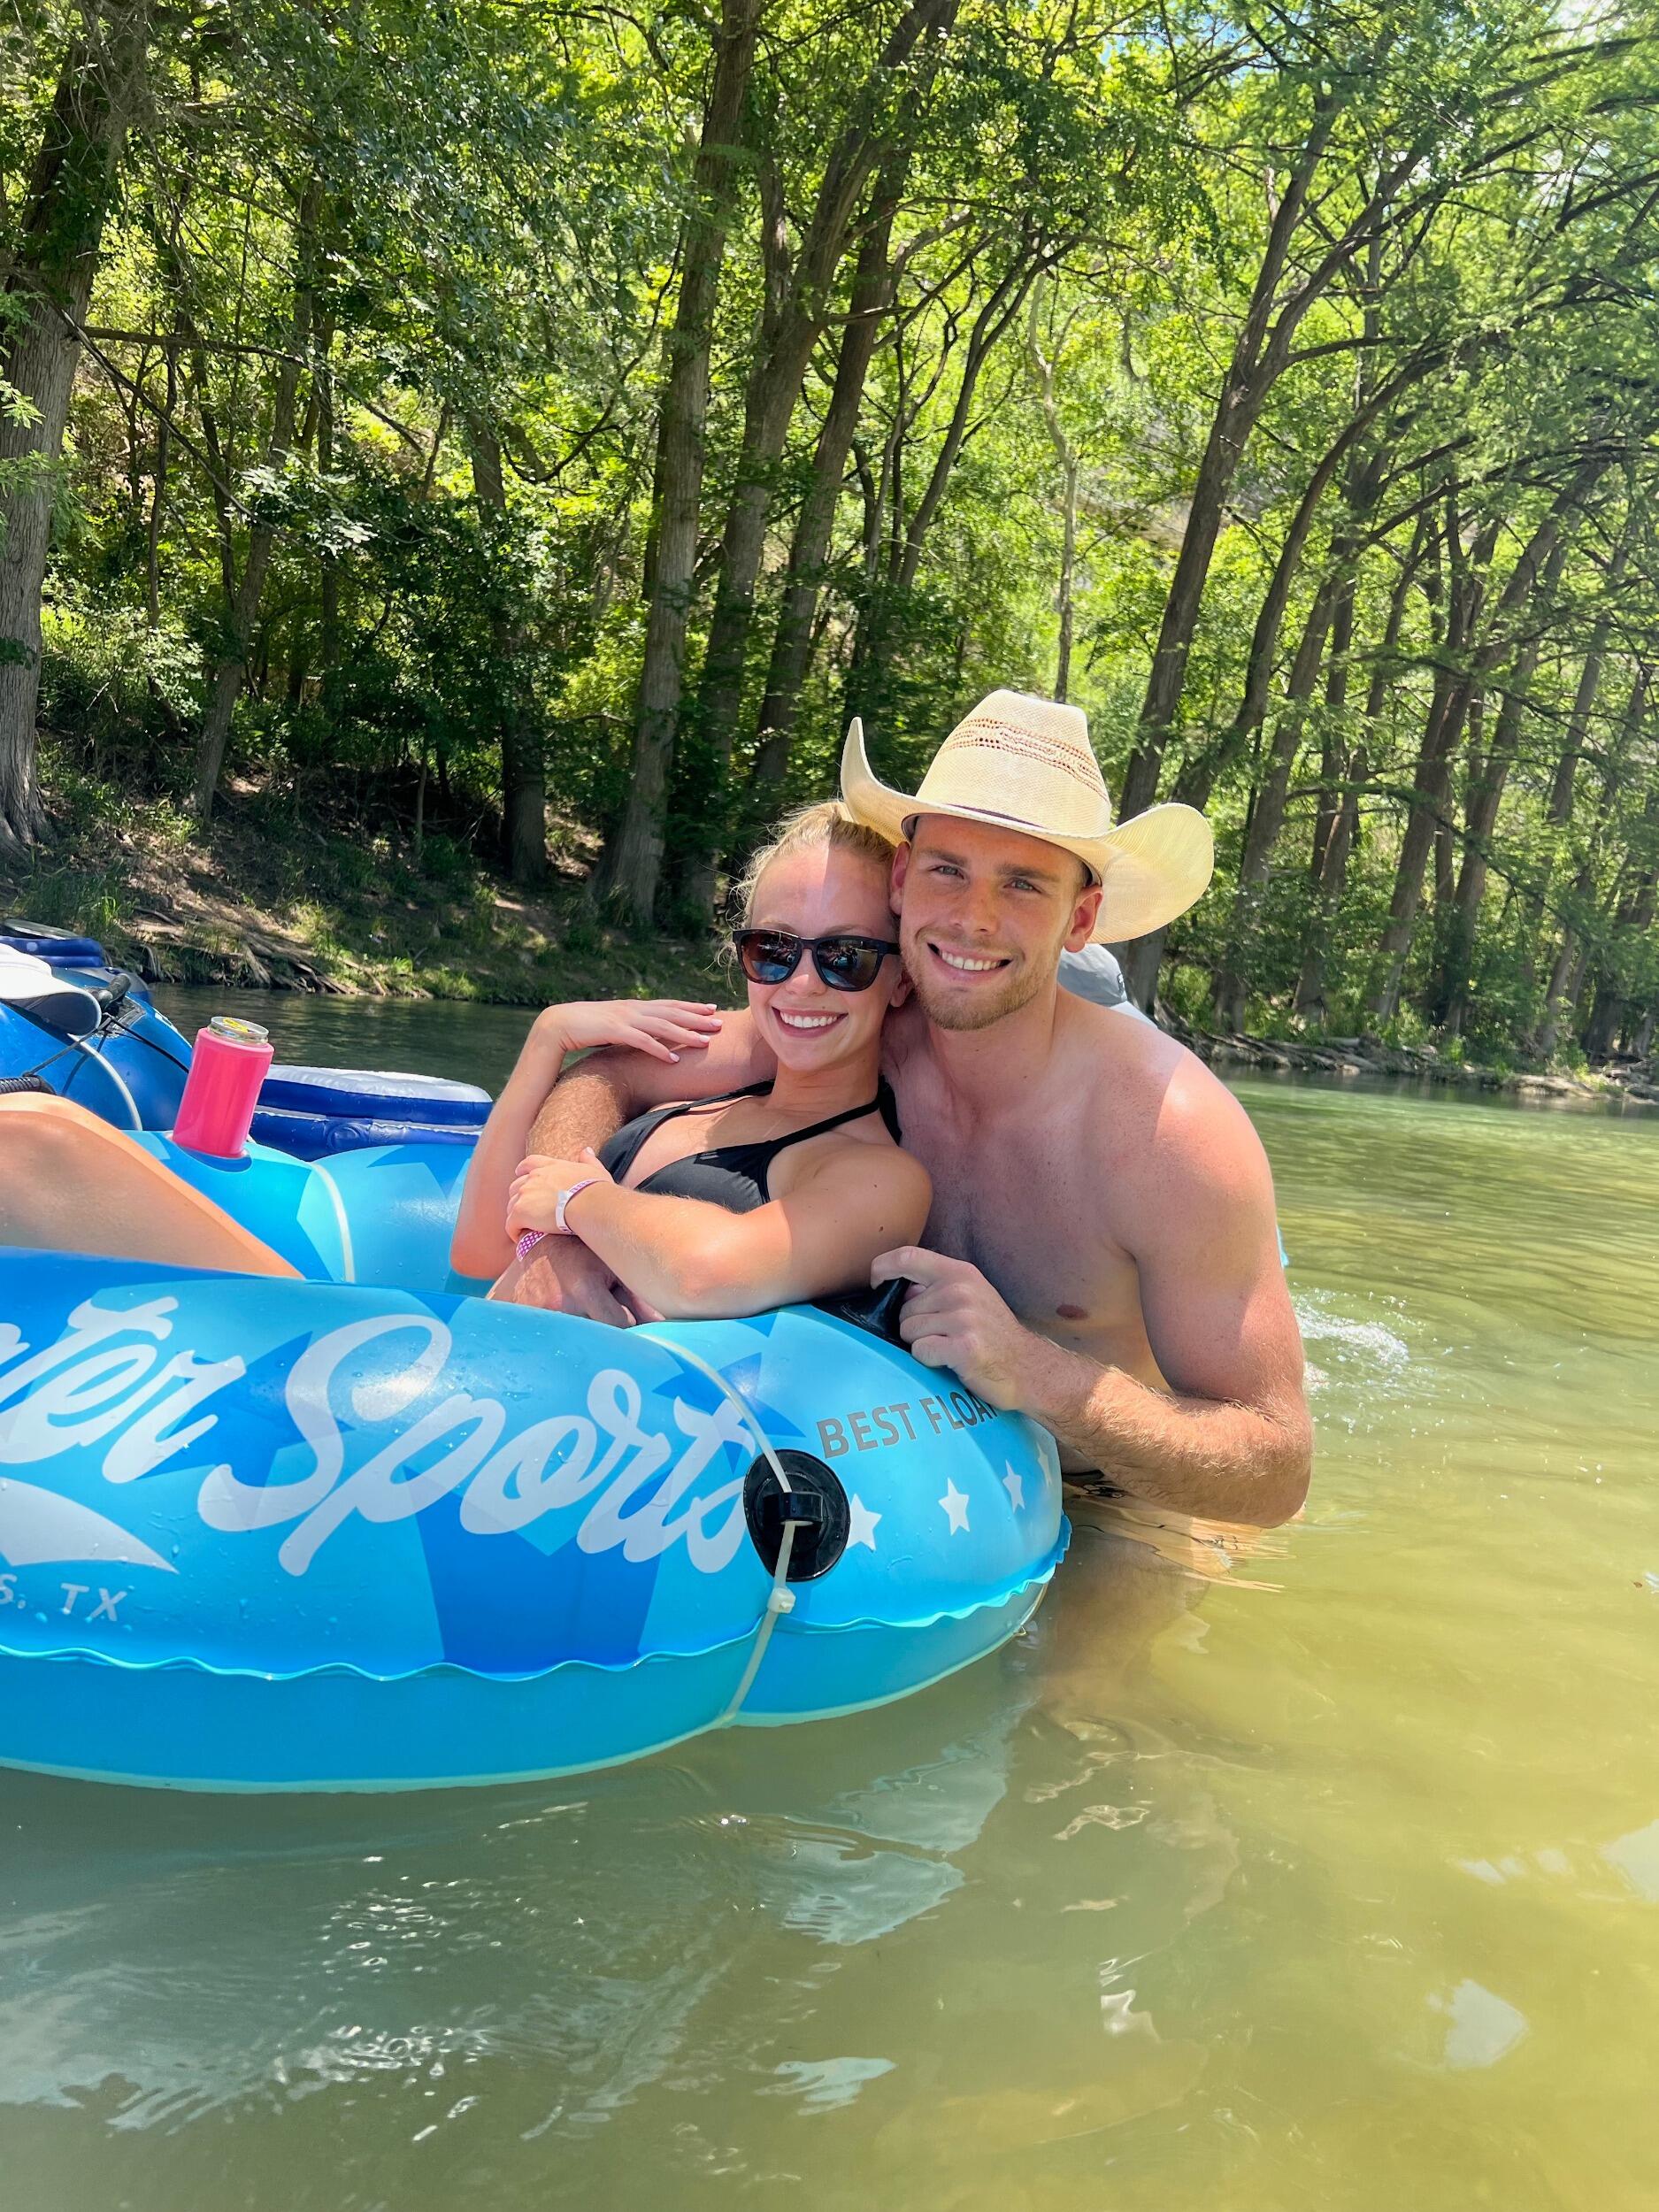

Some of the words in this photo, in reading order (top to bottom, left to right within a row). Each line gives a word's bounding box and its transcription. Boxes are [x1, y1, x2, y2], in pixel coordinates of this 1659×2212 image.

[0, 1297, 247, 1484] ter
[197, 1314, 756, 1576] Sports
[817, 1402, 917, 1459] BEST
[60, 1582, 127, 1622] TX
